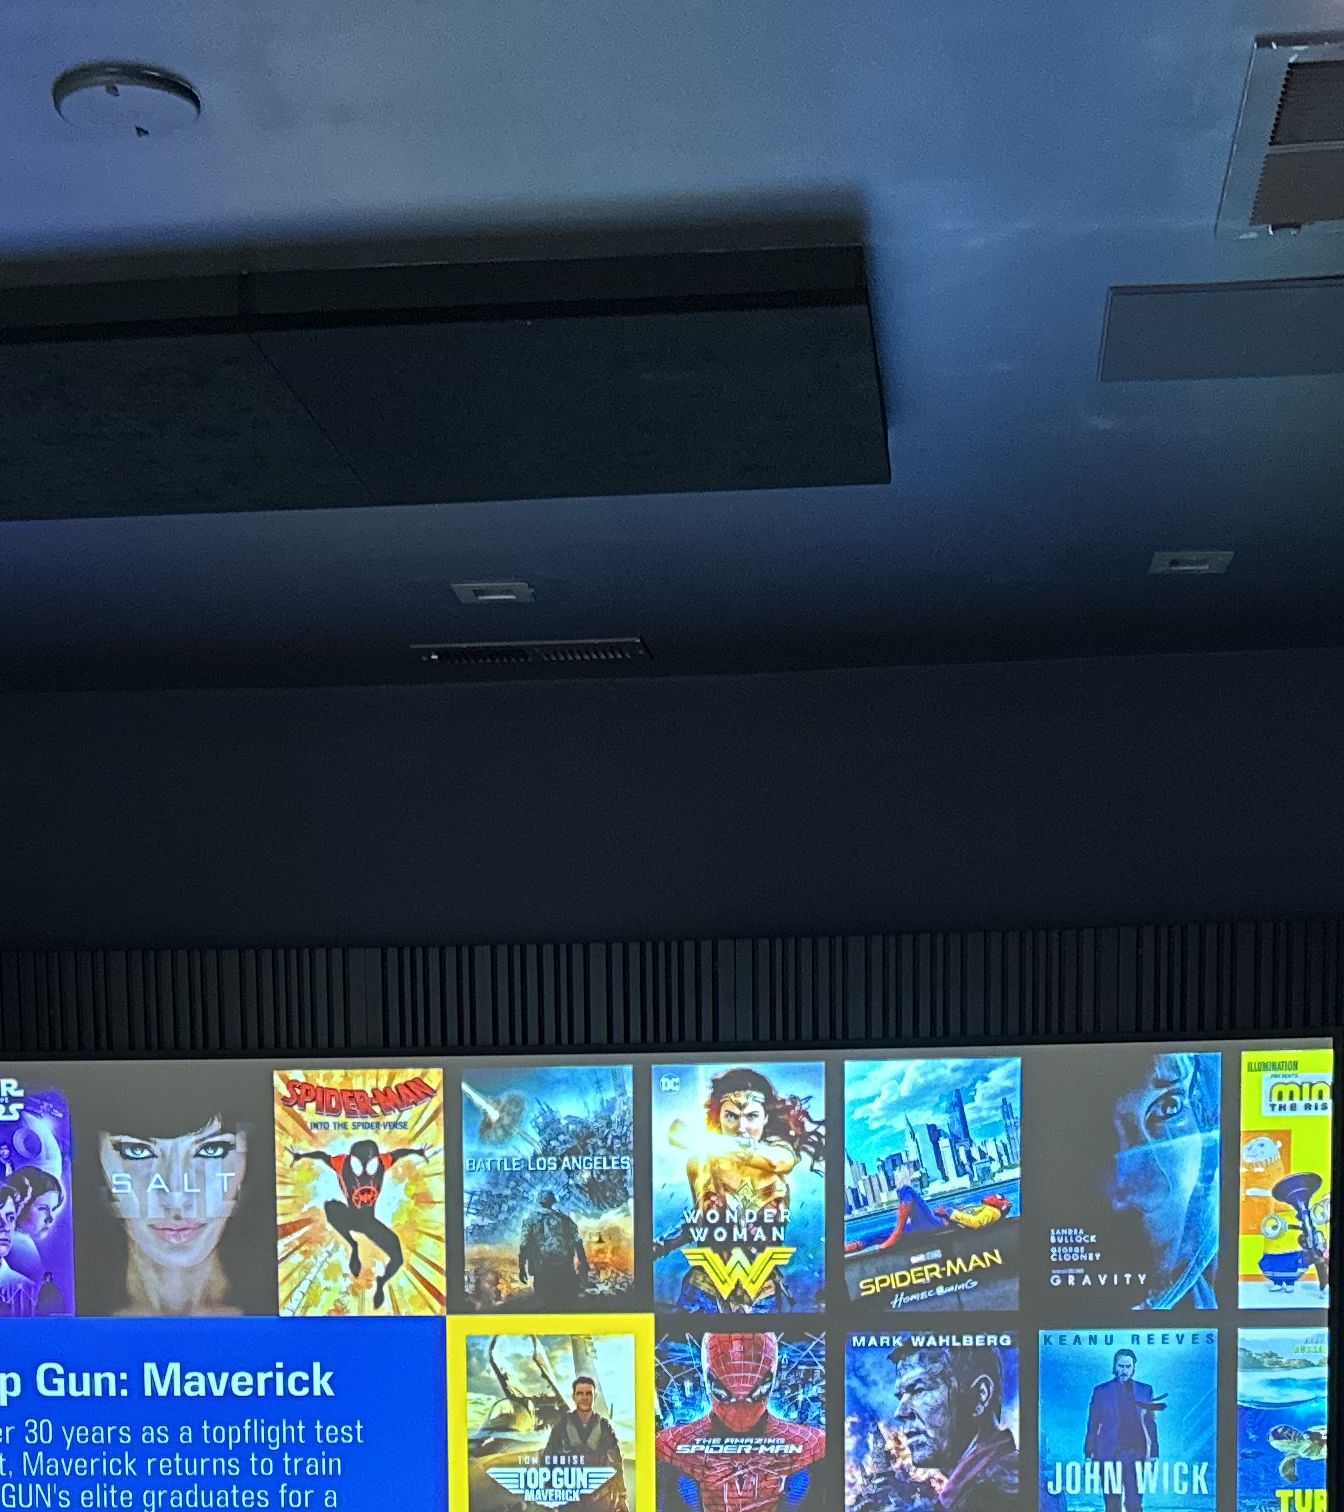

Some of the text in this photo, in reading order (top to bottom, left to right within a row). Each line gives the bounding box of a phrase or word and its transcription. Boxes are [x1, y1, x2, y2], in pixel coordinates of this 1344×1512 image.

[660, 1077, 680, 1092] DC
[281, 1077, 438, 1118] SPIDER-MAN
[1269, 1103, 1297, 1112] THE
[310, 1121, 329, 1130] INTO
[333, 1121, 348, 1130] THE
[466, 1155, 632, 1172] BATTLE LOS ANGELES
[111, 1172, 236, 1194] SALT
[683, 1208, 792, 1223] WONDER
[689, 1226, 785, 1242] WOMAN
[1050, 1234, 1097, 1243] BULLOCK
[1050, 1252, 1101, 1261] CLOONEY
[859, 1248, 1003, 1297] SPIDER-MAN
[1050, 1273, 1147, 1287] GRAVITY
[852, 1334, 1012, 1347] MARK WAHLBERG
[1043, 1333, 1215, 1346] KEANU REEVES
[36, 1362, 128, 1397] Gun:
[143, 1361, 335, 1397] Maverick
[24, 1418, 53, 1444] 30
[61, 1425, 131, 1451] years
[141, 1425, 169, 1444] as
[179, 1425, 193, 1444] a
[202, 1418, 306, 1450] topflight
[314, 1419, 364, 1444] test
[676, 1444, 804, 1454] SPIDER-MAN
[22, 1451, 137, 1476] Maverick
[147, 1452, 240, 1476] returns
[249, 1452, 273, 1476] to
[282, 1451, 342, 1476] train
[518, 1467, 588, 1489] TOP GUN
[1047, 1461, 1209, 1495] JOHN WICK
[80, 1483, 133, 1508] elite
[279, 1483, 314, 1508] for
[324, 1489, 337, 1508] a
[524, 1488, 580, 1502] MAVERICK
